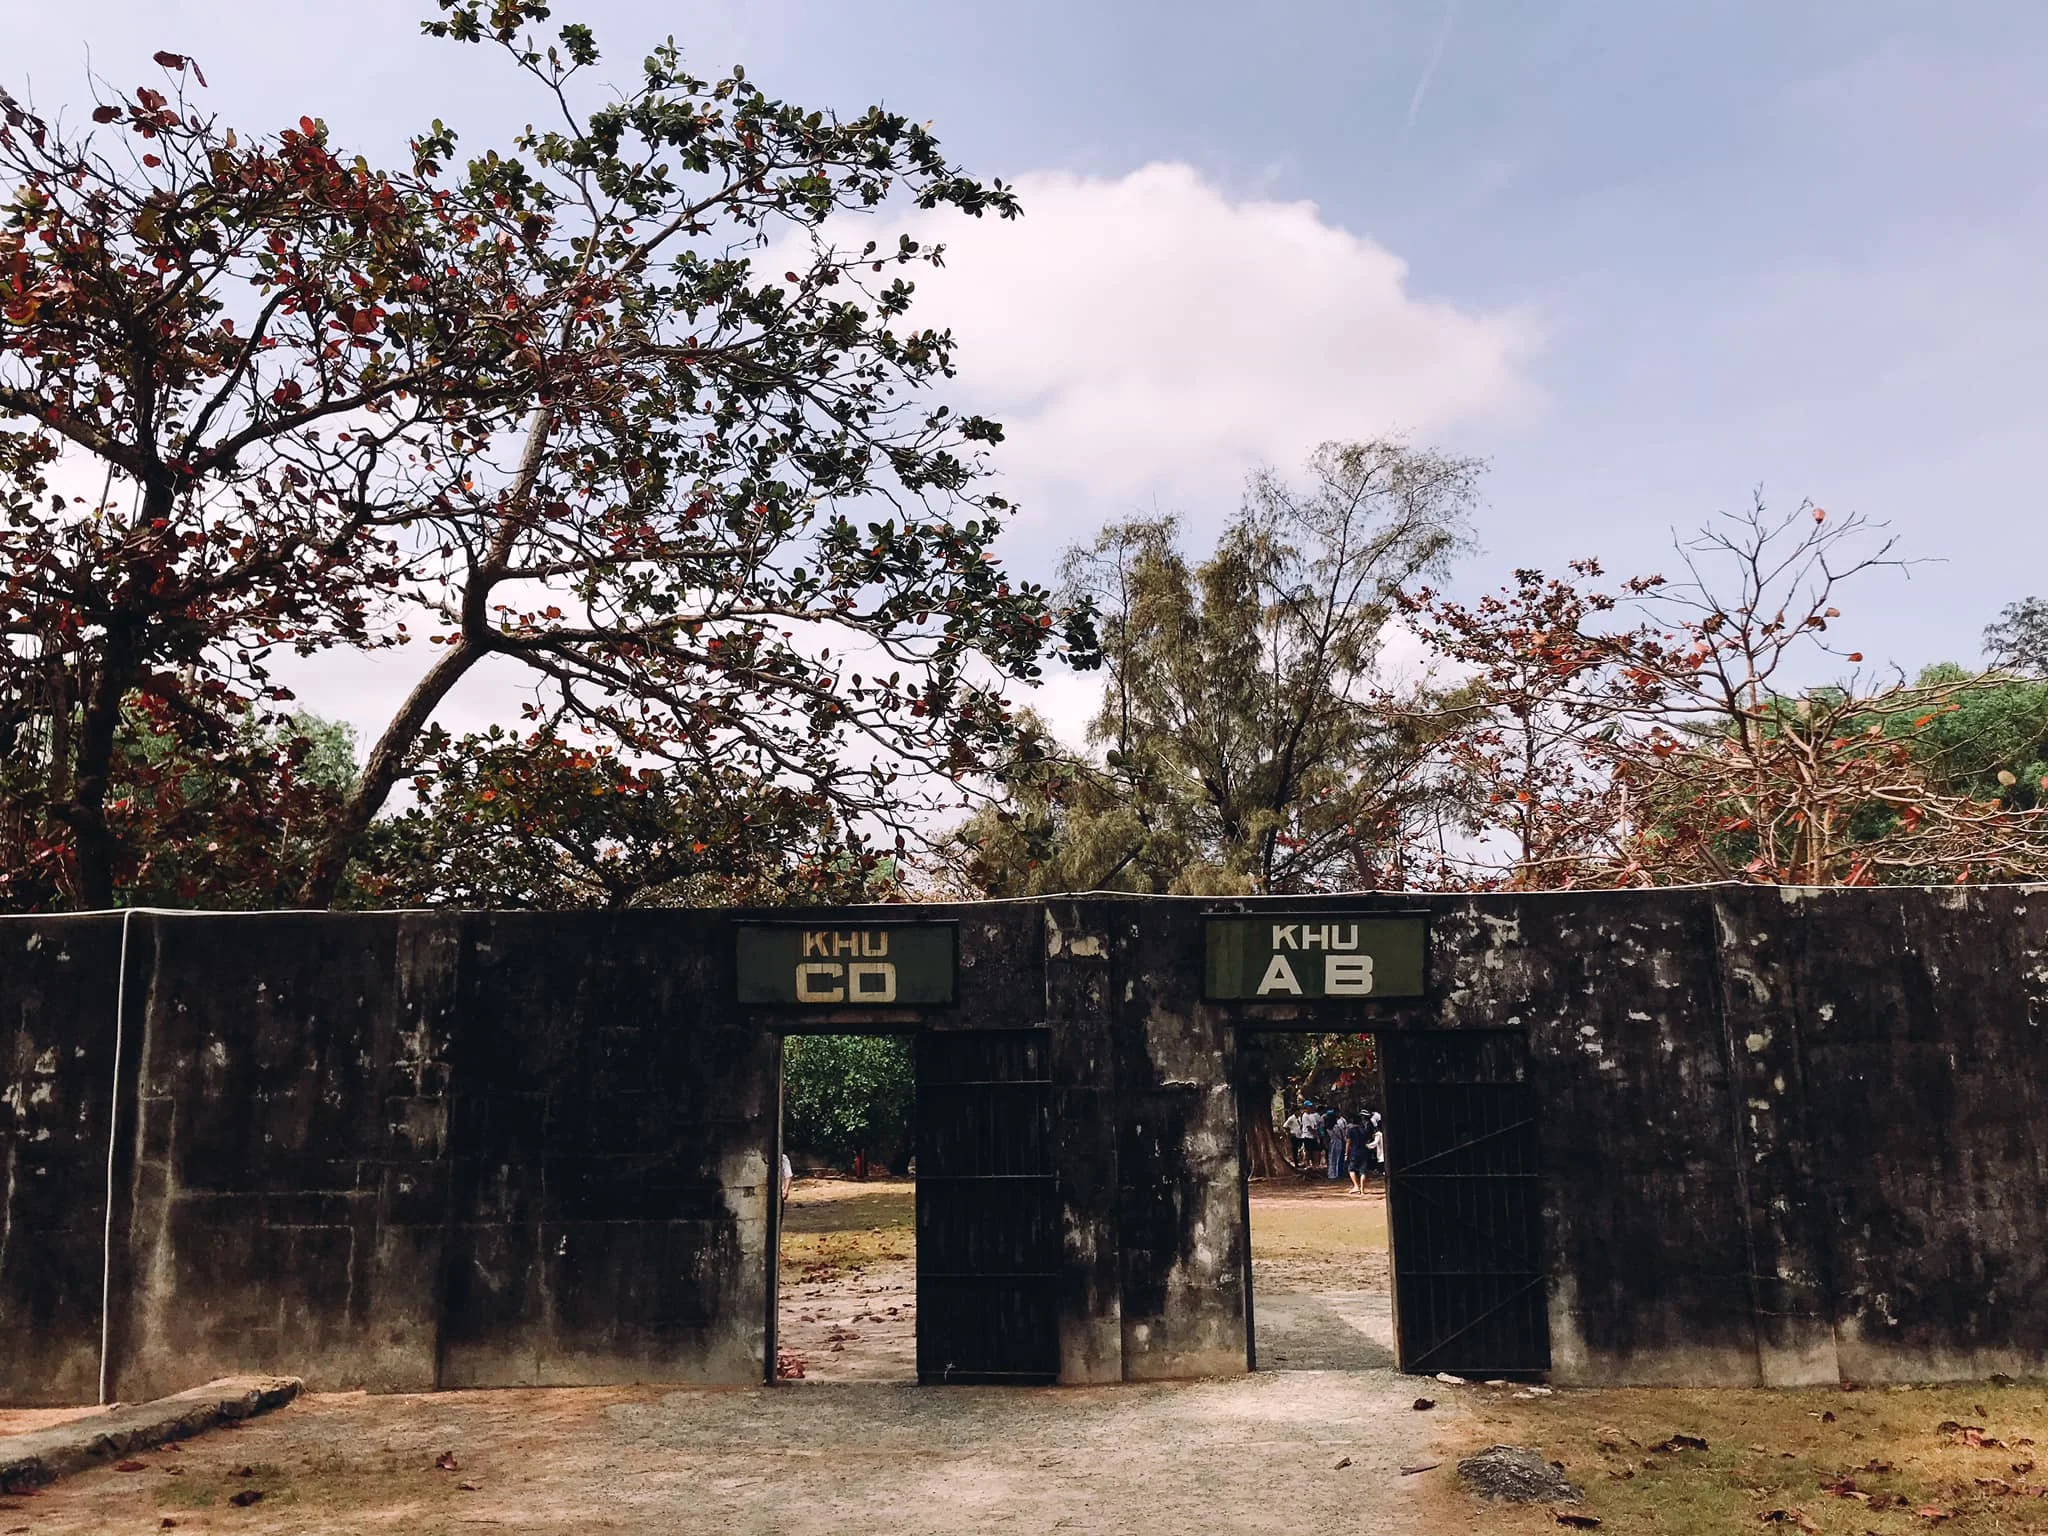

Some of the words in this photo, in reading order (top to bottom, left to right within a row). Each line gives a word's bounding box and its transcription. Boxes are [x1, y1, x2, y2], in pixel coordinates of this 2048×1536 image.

[802, 931, 889, 957] KHU
[1272, 924, 1359, 950] KHU
[795, 962, 897, 1003] CD
